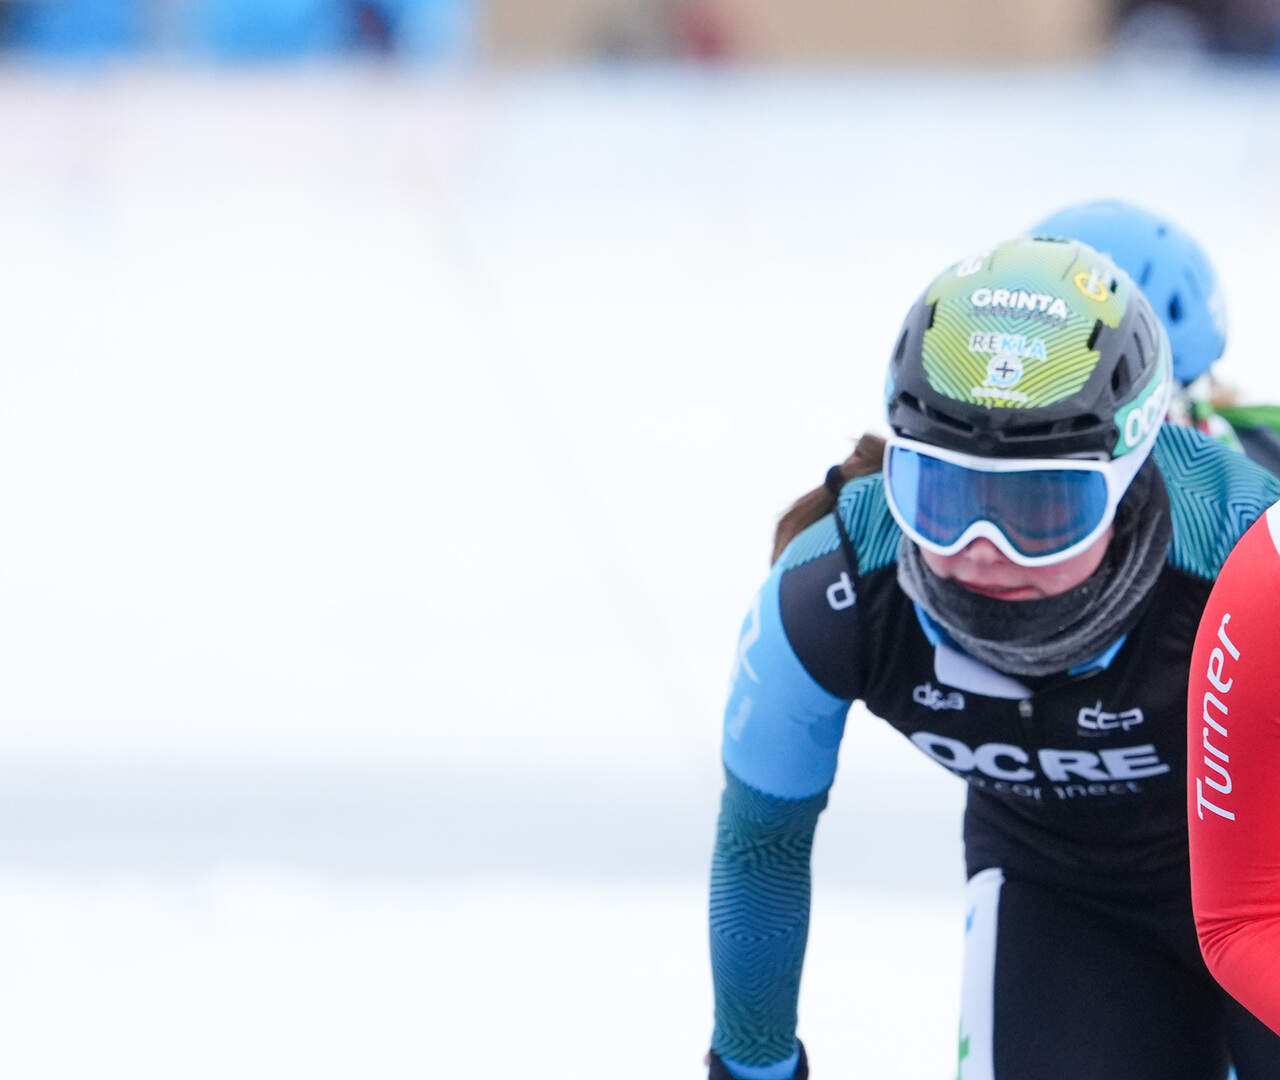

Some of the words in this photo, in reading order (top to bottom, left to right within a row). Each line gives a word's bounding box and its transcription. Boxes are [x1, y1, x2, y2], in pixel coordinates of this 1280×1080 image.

[971, 288, 1068, 320] GRINTA
[971, 333, 1047, 360] REKLA
[1196, 612, 1241, 822] Turner
[909, 730, 1172, 783] OCRE
